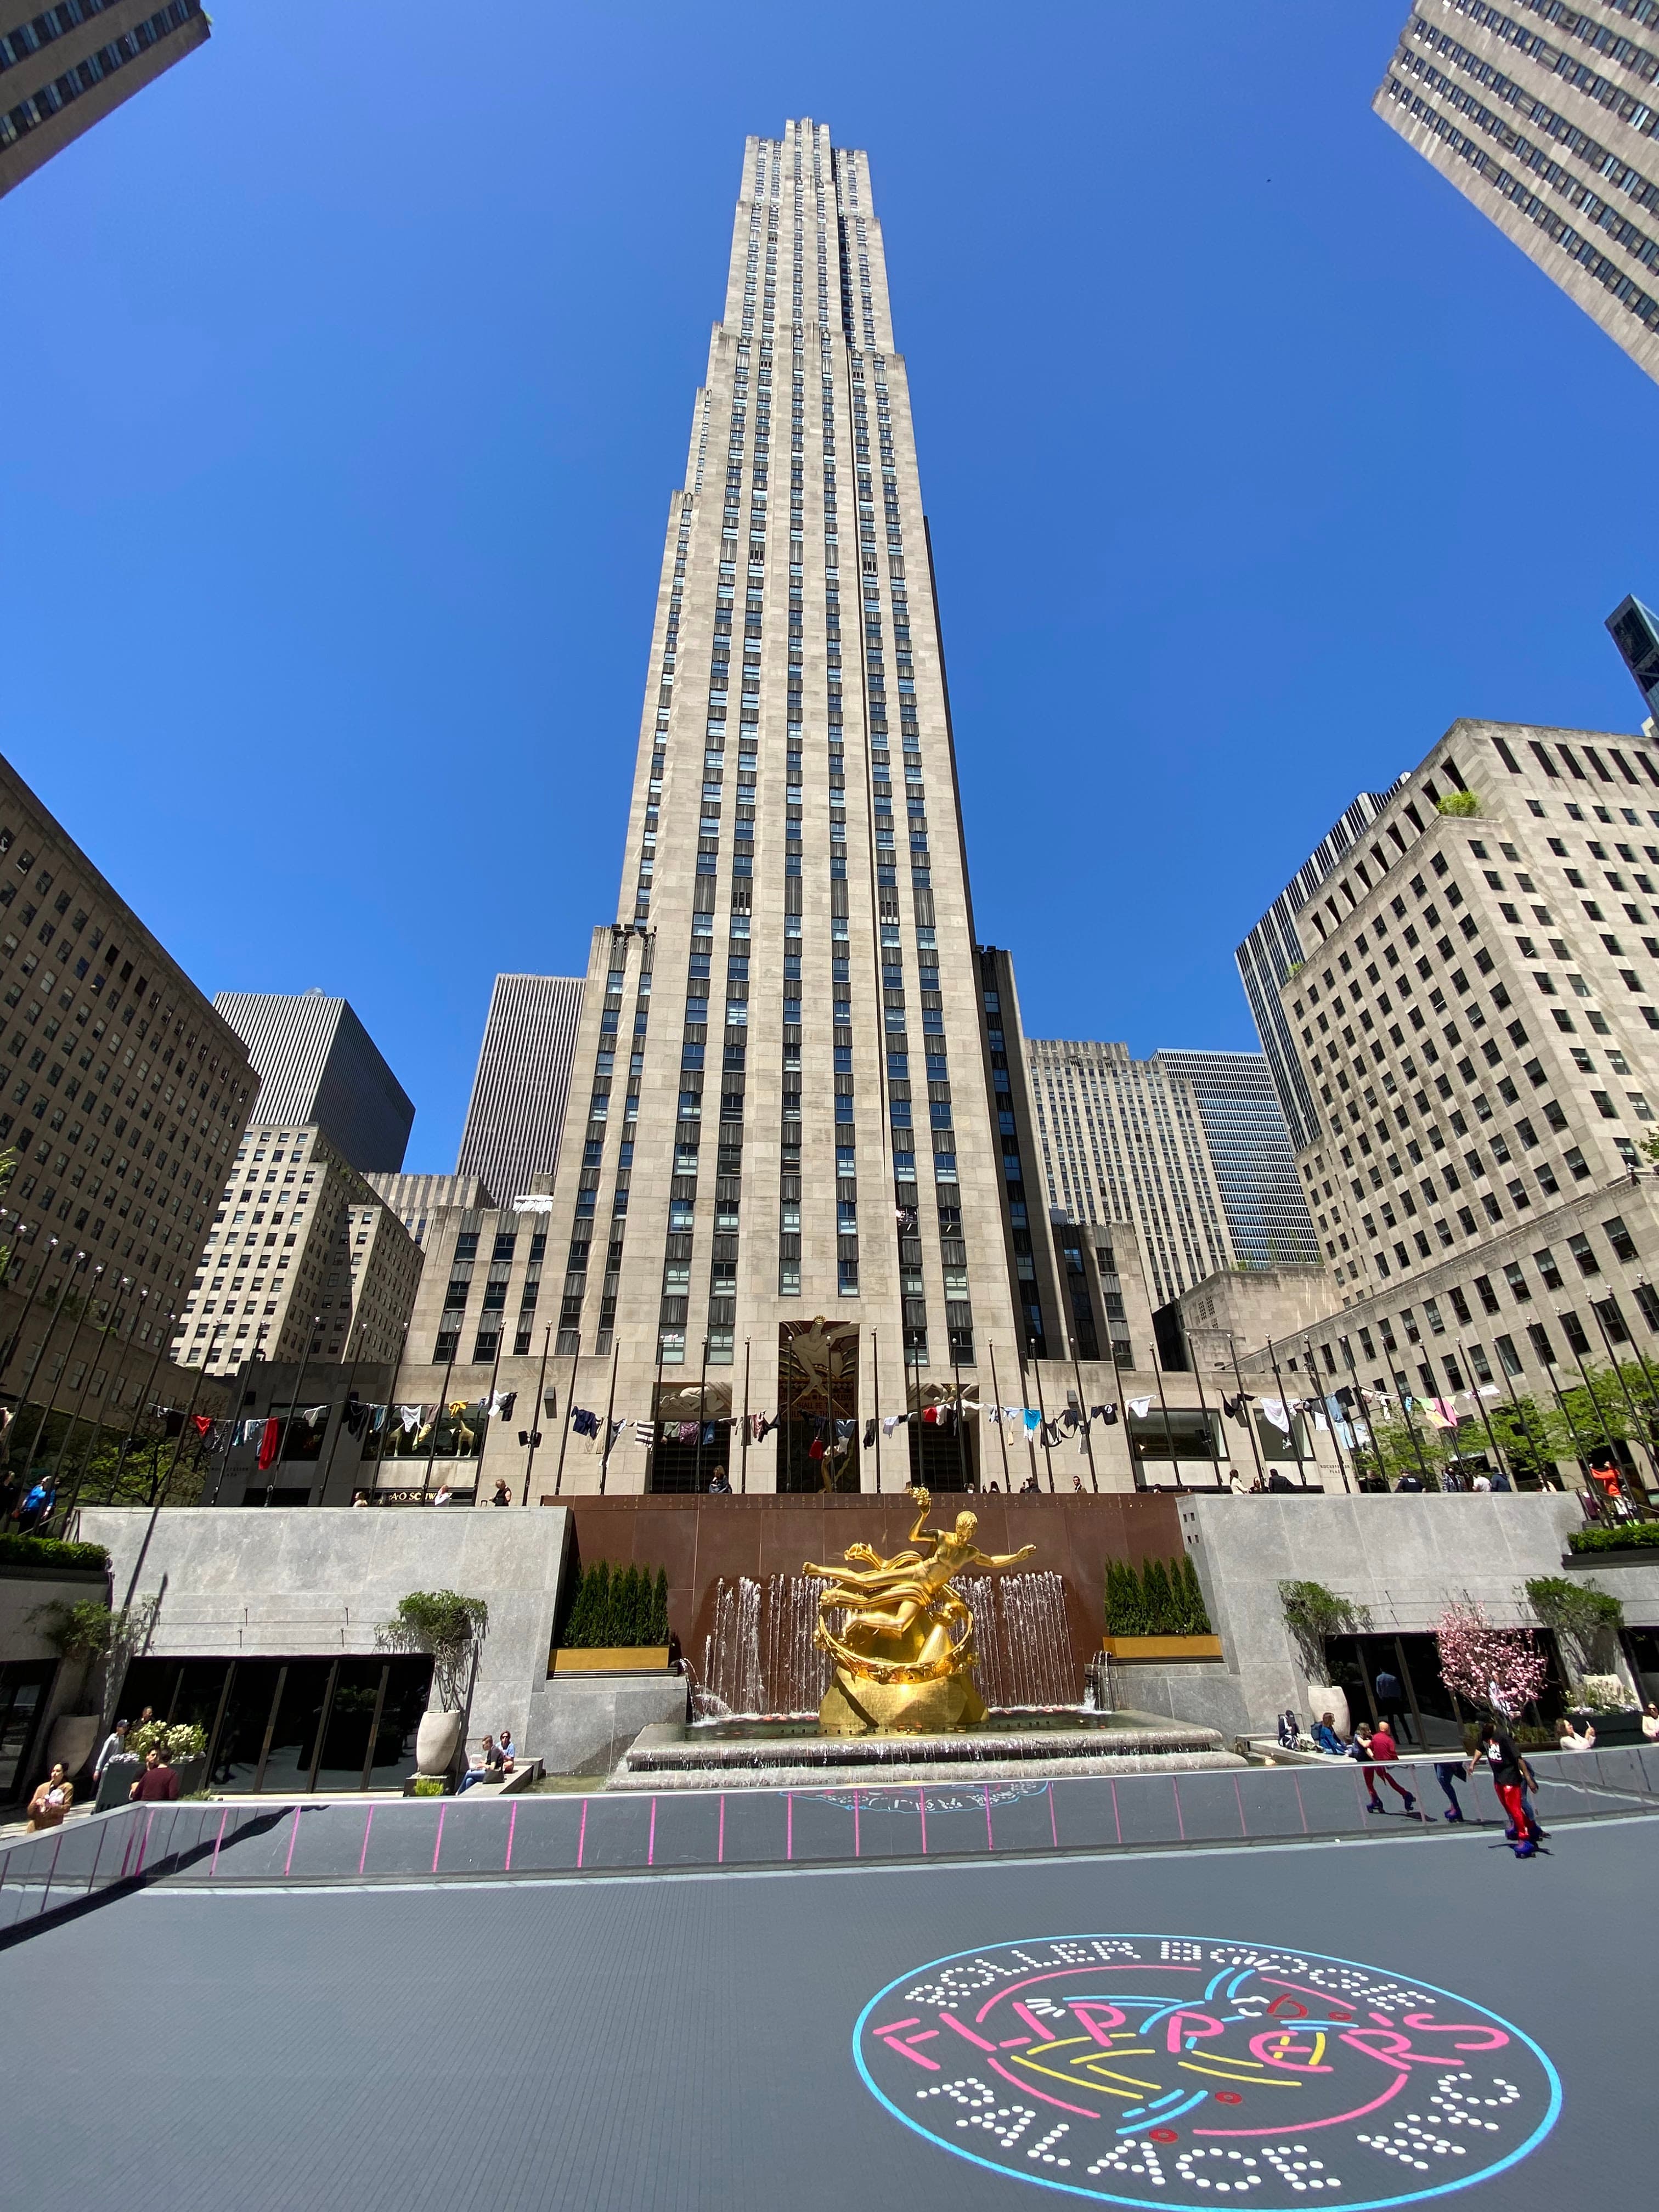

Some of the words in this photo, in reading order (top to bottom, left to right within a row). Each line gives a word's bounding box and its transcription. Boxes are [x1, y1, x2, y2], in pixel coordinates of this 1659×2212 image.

[905, 1940, 1142, 2008] ROLLER
[1160, 1940, 1436, 2011] BOOGIE
[873, 2002, 1510, 2073] FLIPPER'S
[916, 2077, 1342, 2192] PALACE
[1356, 2072, 1521, 2170] NYC
